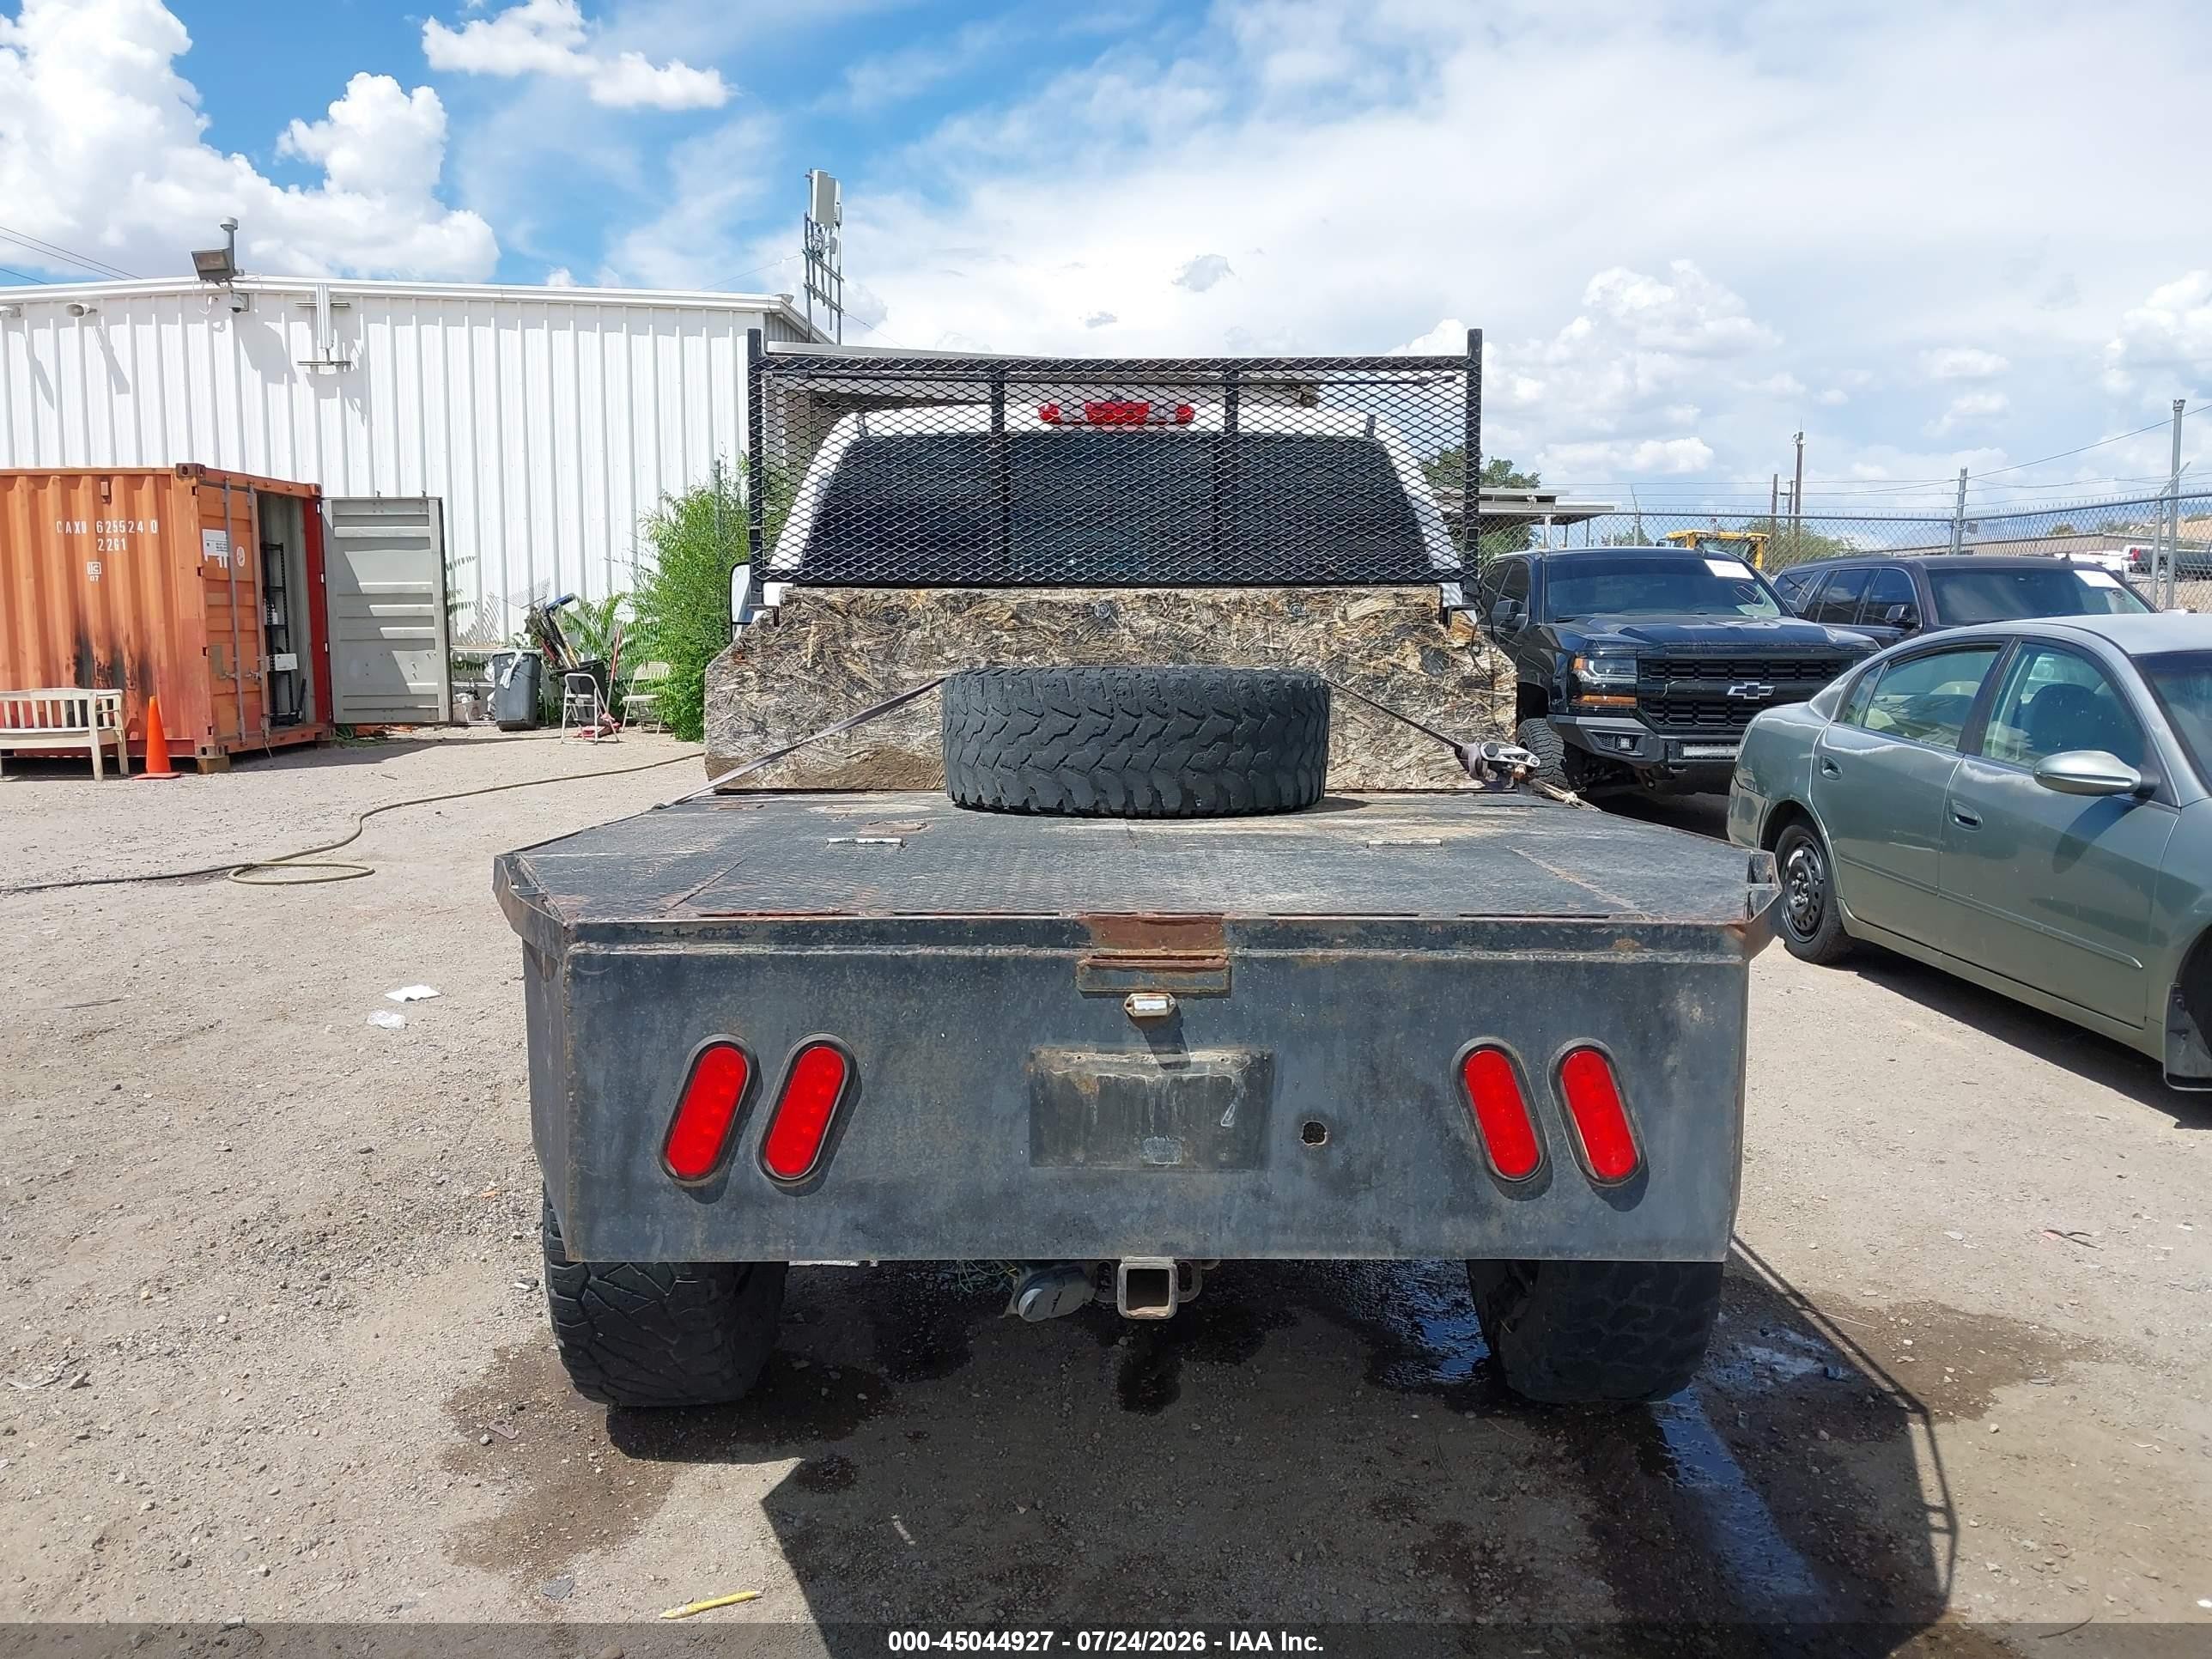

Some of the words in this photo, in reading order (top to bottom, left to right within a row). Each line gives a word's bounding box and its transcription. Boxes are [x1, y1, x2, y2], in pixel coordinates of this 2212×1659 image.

[56, 520, 88, 534] CAXU
[95, 520, 144, 534] 625524
[97, 538, 128, 551] 22G1
